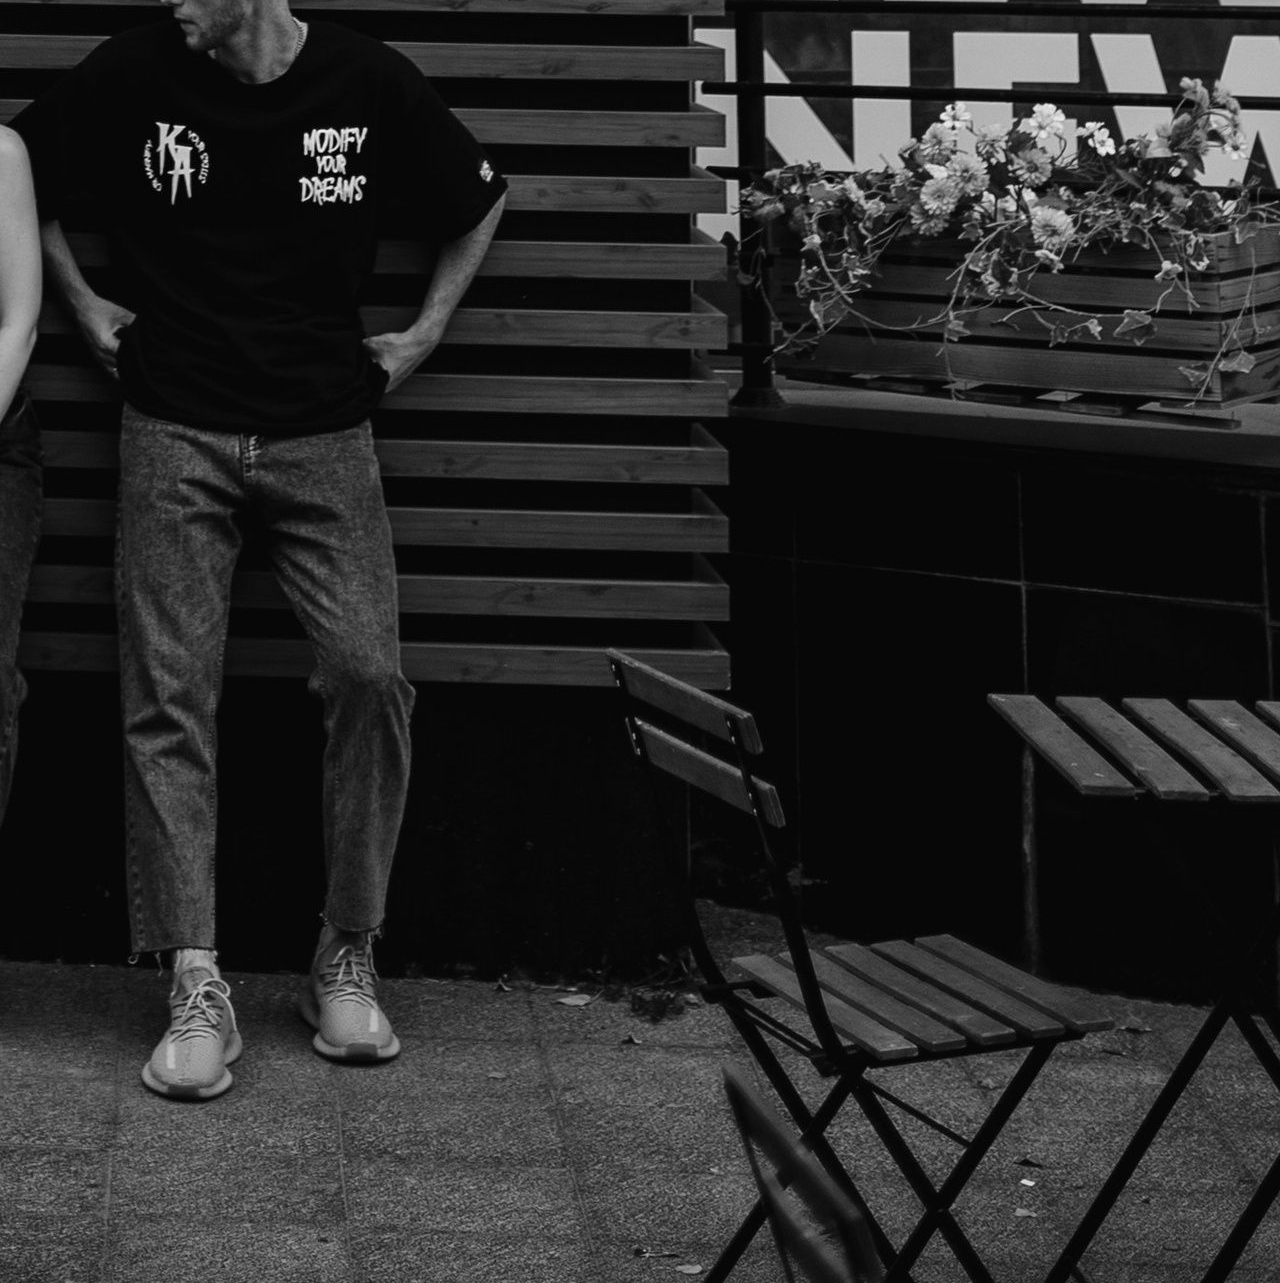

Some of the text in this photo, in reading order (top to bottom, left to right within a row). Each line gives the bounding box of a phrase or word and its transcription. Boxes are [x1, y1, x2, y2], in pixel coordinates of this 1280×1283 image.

[303, 127, 369, 158] MODIFY
[315, 154, 347, 175] YOUR
[298, 175, 367, 207] DREAMS
